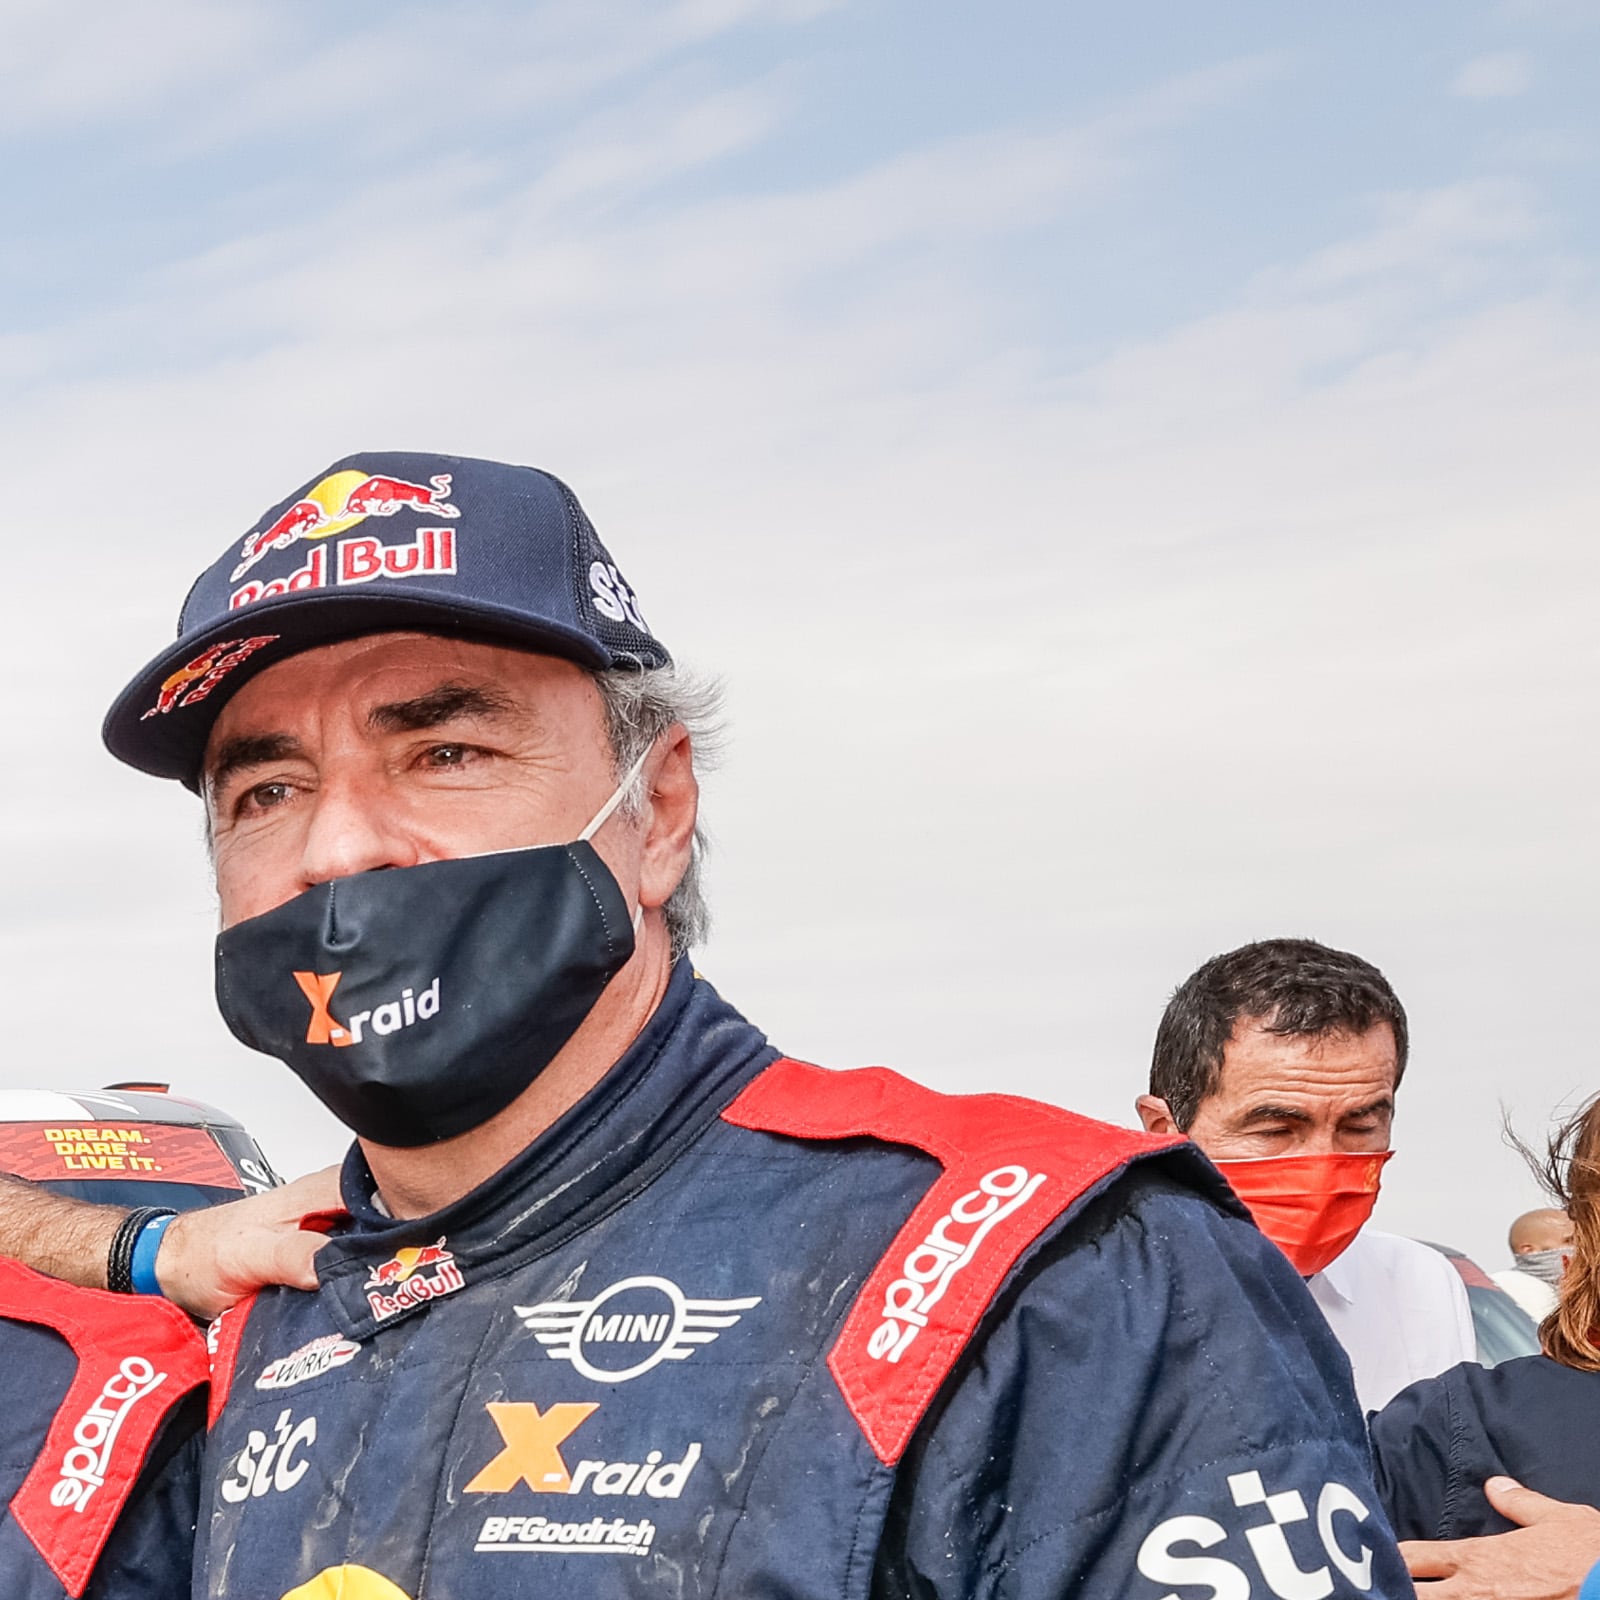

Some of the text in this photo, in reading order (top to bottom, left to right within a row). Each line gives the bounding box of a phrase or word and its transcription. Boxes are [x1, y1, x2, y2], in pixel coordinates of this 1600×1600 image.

[337, 528, 457, 585] Bull
[44, 1128, 152, 1144] DREAM.
[55, 1141, 138, 1156] DARE.
[64, 1155, 163, 1172] LIVE IT.
[409, 1260, 465, 1300] Bull
[866, 1164, 1038, 1364] sparco
[585, 1312, 670, 1345] MINI
[276, 1346, 336, 1382] WORKS
[49, 1354, 162, 1514] sparco
[221, 1408, 317, 1503] stc
[477, 1516, 656, 1546] BFGoodrich
